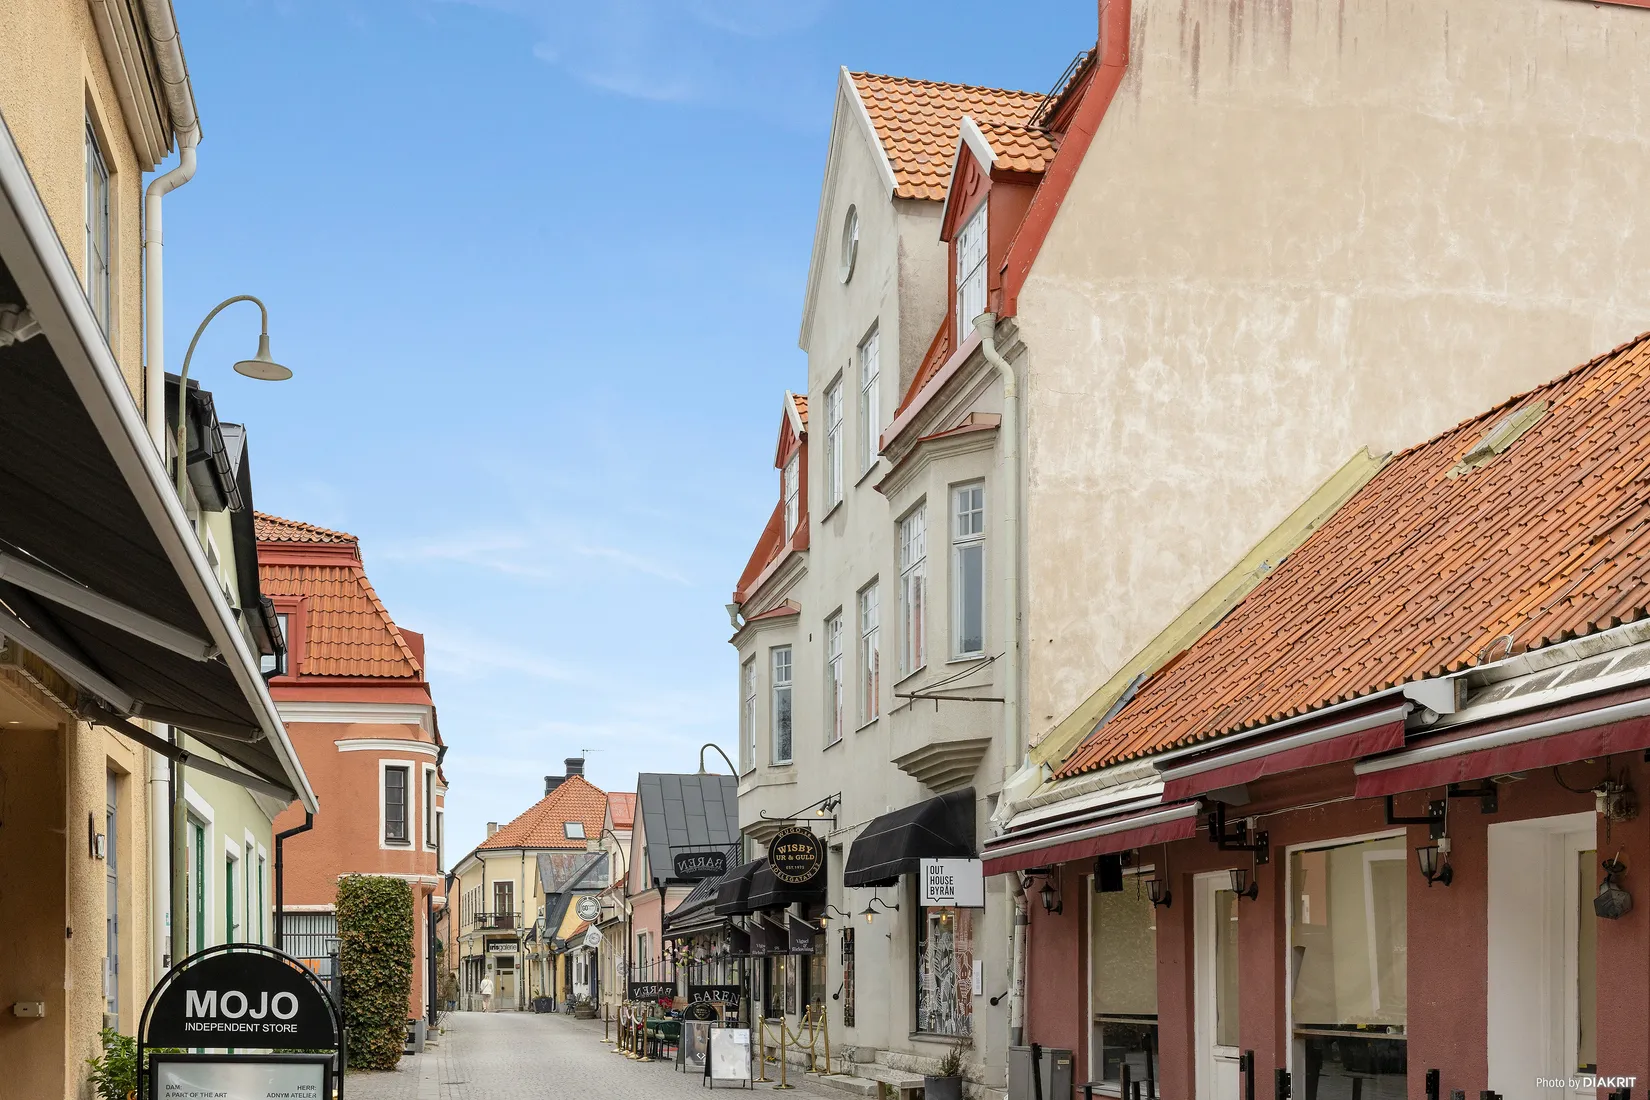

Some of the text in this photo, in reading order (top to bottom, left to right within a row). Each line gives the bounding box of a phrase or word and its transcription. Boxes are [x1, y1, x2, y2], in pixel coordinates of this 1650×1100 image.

[777, 843, 813, 854] WISBY
[930, 865, 944, 875] OUT
[930, 876, 954, 885] HOUSE
[930, 884, 955, 896] BYRÅN
[693, 989, 741, 1004] BAREN
[185, 989, 299, 1020] MOJO
[185, 1022, 298, 1033] INDEPENDENT STORE
